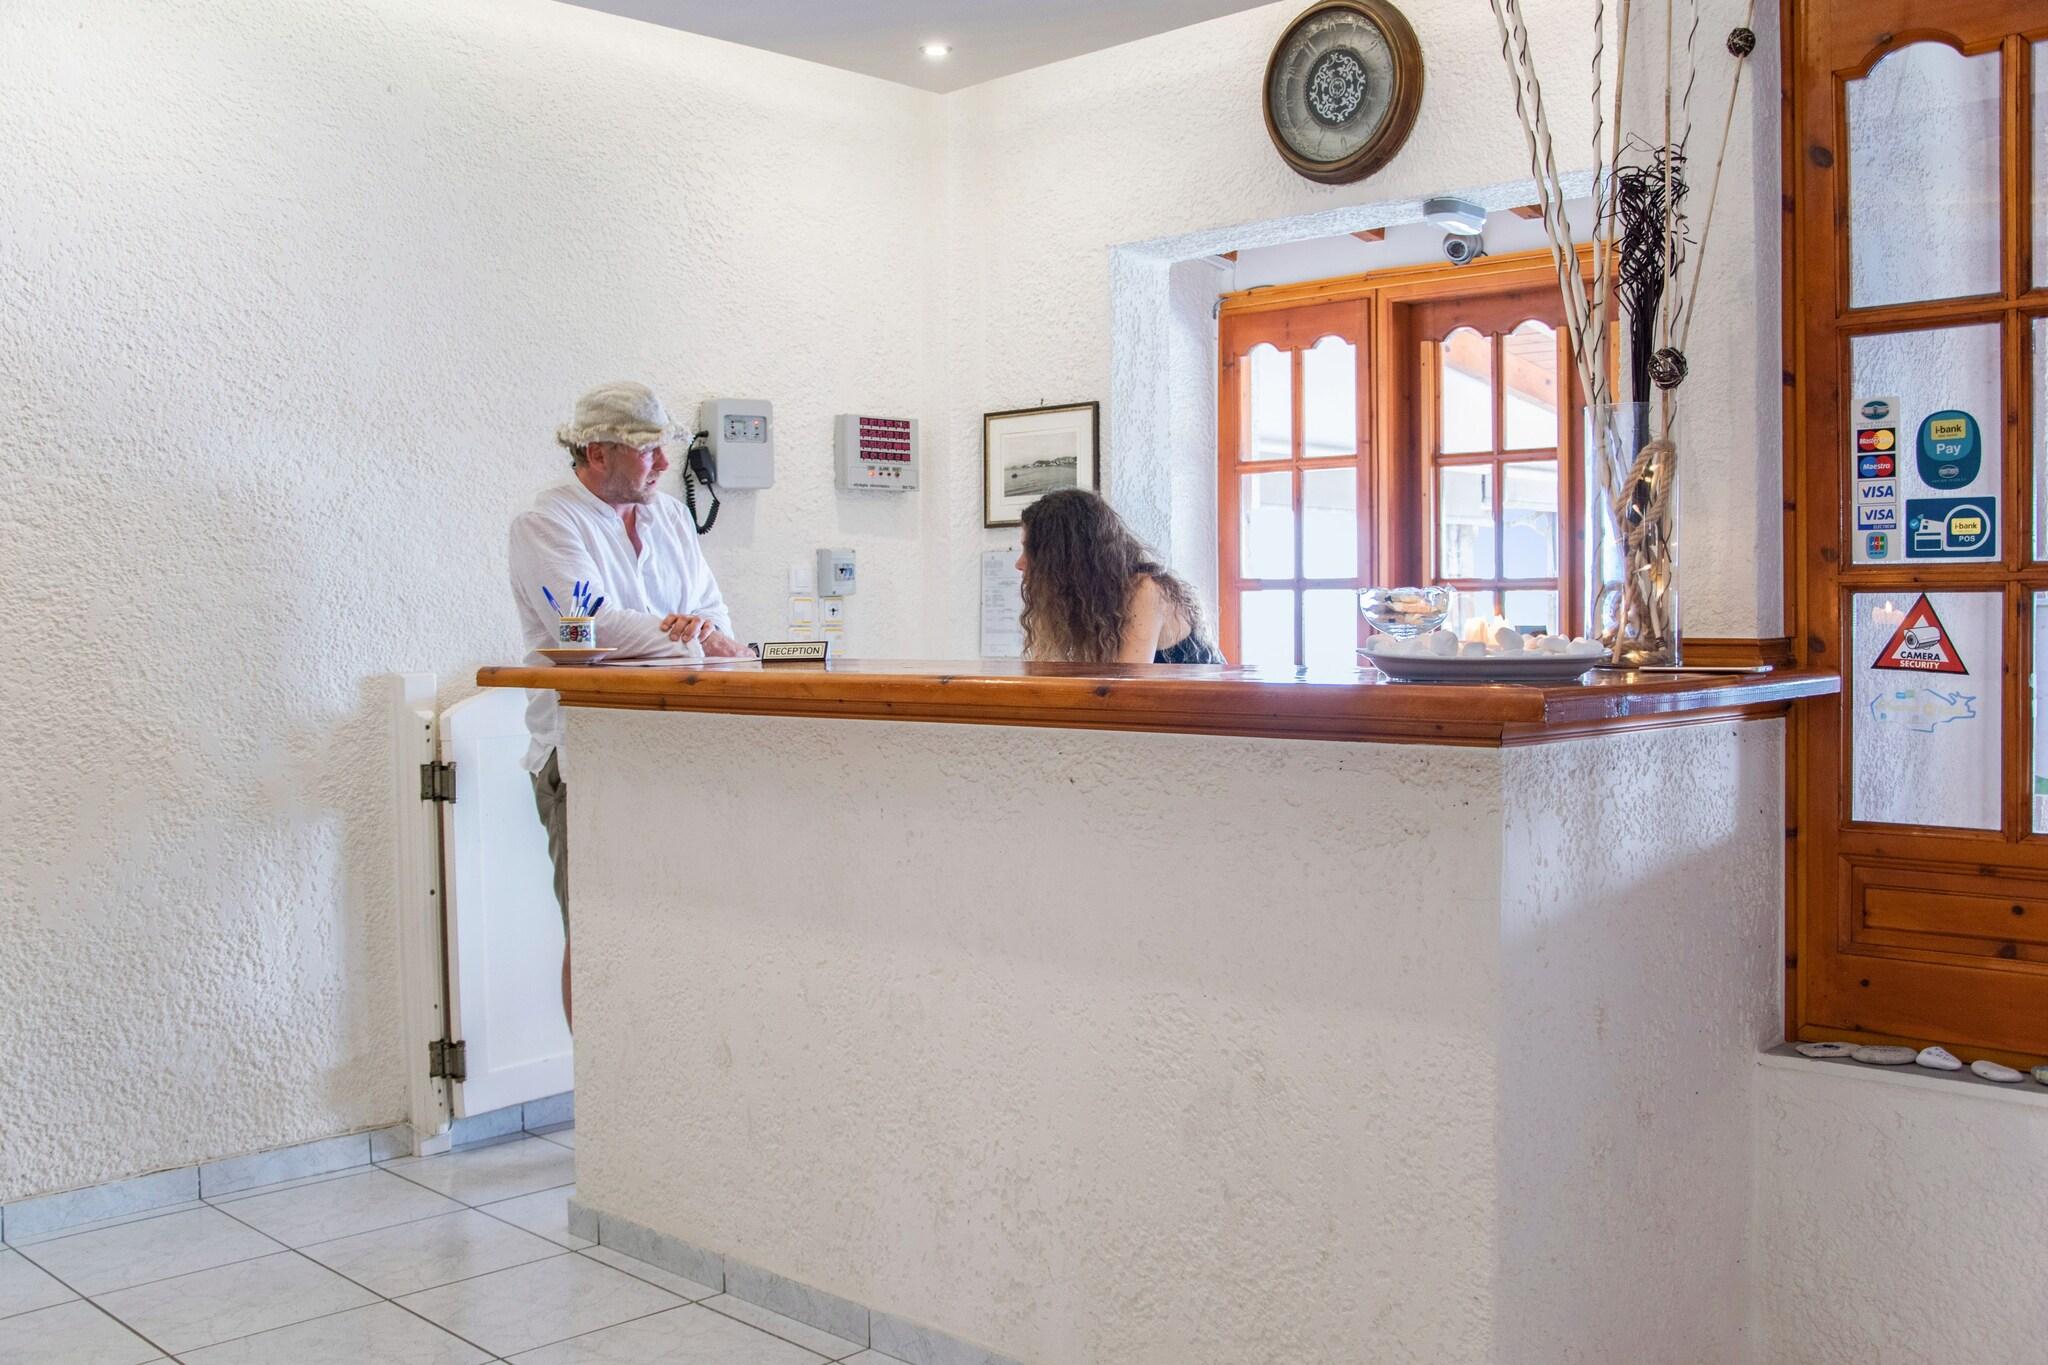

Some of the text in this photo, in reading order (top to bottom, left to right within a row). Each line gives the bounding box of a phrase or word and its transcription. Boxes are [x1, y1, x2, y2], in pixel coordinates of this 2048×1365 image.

[1935, 424, 1962, 434] i-bank
[1859, 436, 1893, 445] Master
[1936, 443, 1961, 455] Pay
[1862, 485, 1894, 498] VISA
[1865, 509, 1894, 520] VISA
[1954, 522, 1977, 530] i-bank
[769, 646, 820, 655] RECEPTION
[1900, 651, 1940, 660] CAMERA
[1900, 660, 1940, 669] SECURITY
